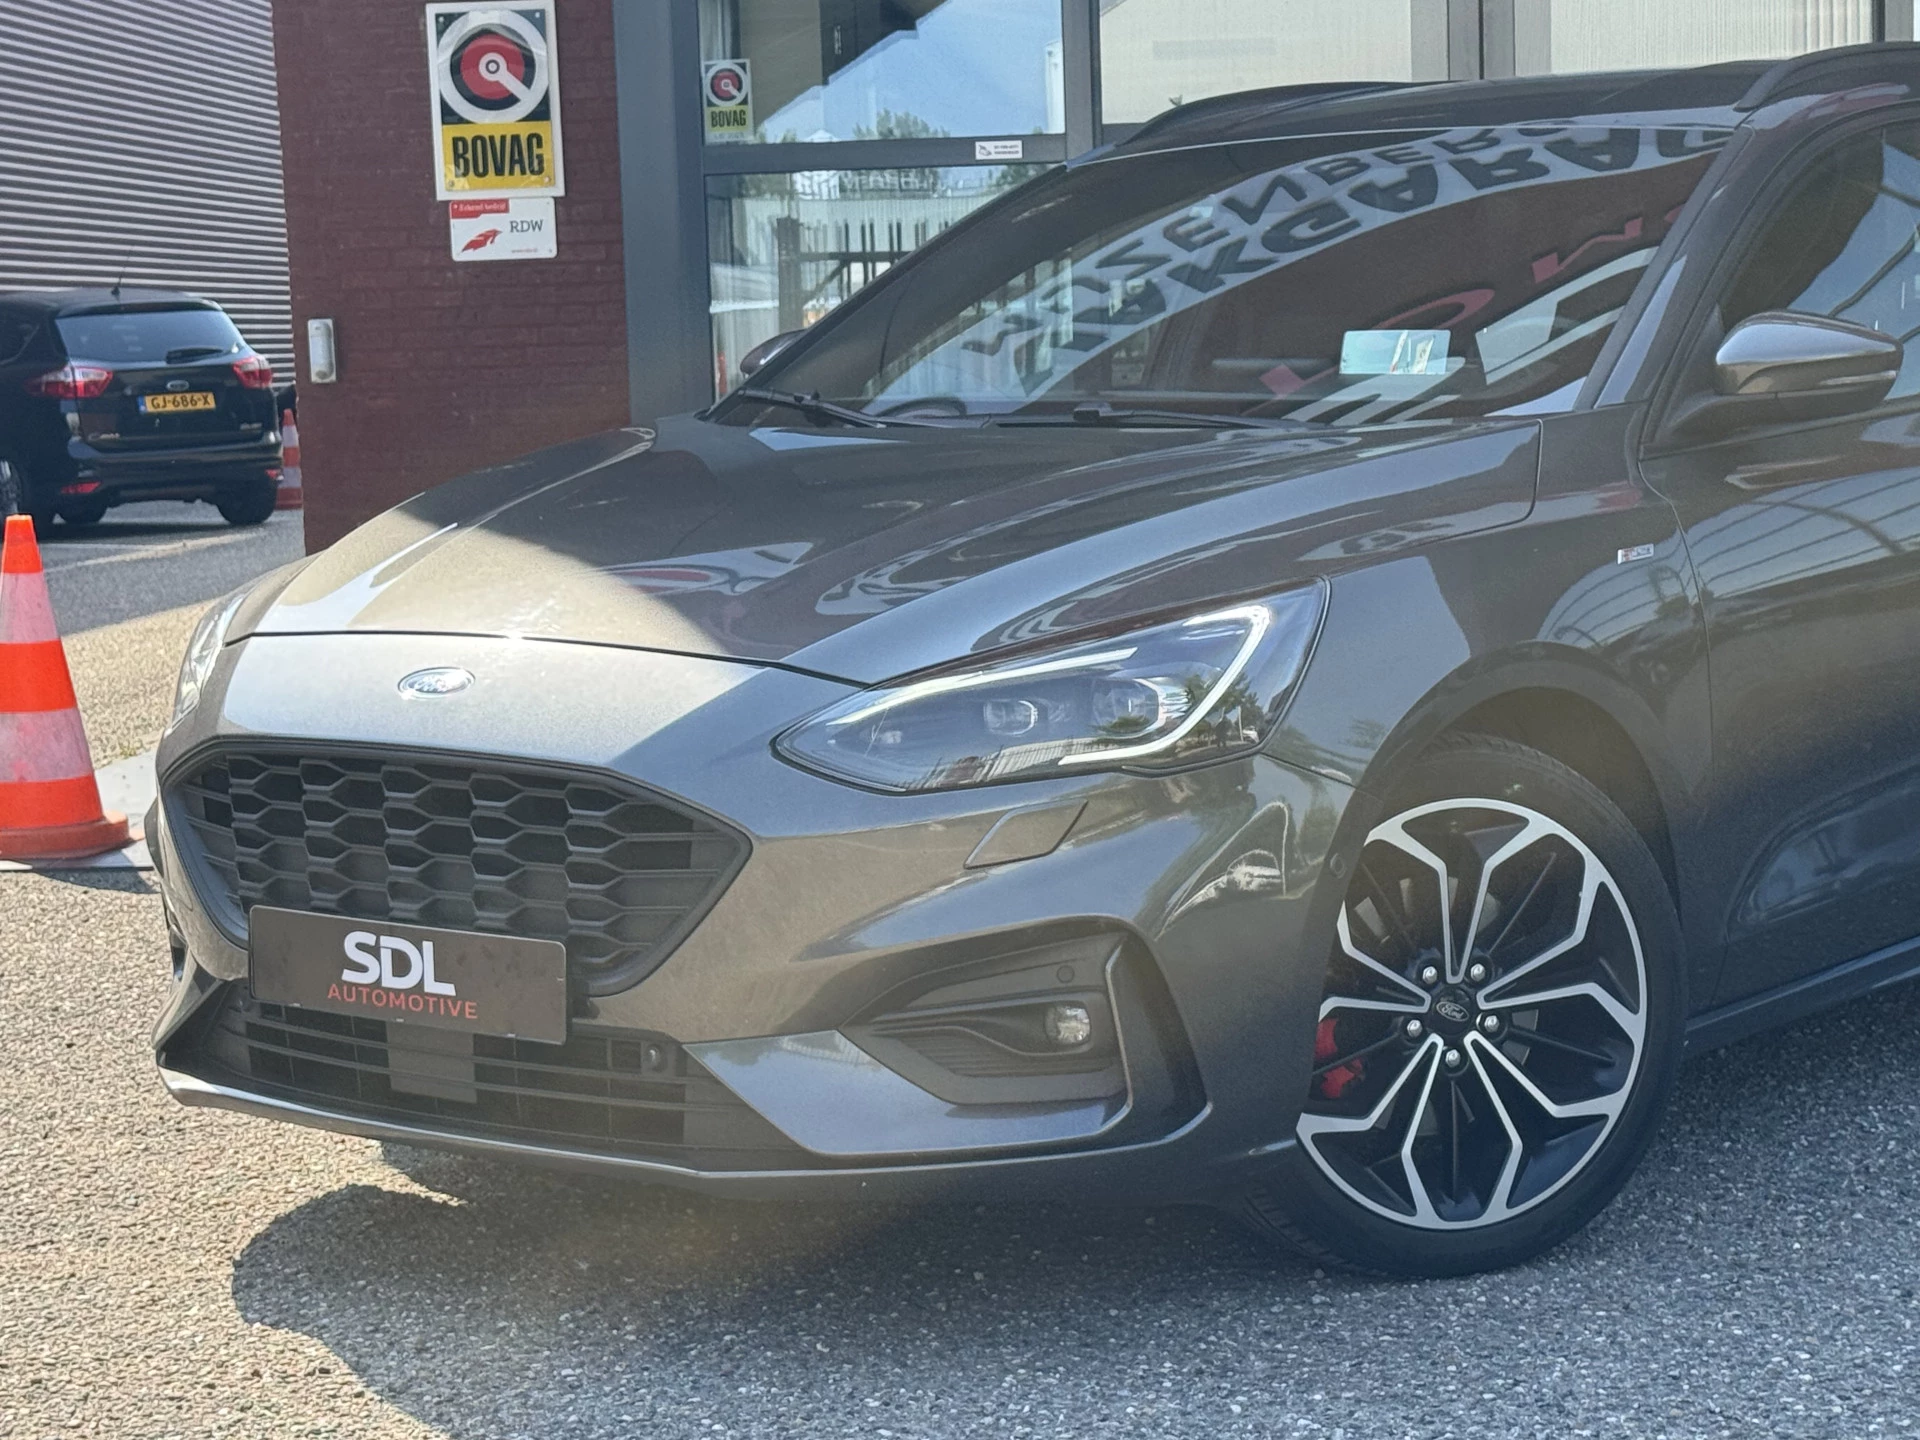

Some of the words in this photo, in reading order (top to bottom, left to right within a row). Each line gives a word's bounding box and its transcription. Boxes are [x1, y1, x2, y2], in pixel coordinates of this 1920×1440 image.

[710, 109, 747, 128] BOVAG
[452, 132, 545, 178] BOVAG
[509, 219, 544, 233] RDW
[151, 394, 211, 409] GJ-686-X
[341, 931, 456, 996] SDL
[327, 983, 479, 1020] AUTOMOTIVE
